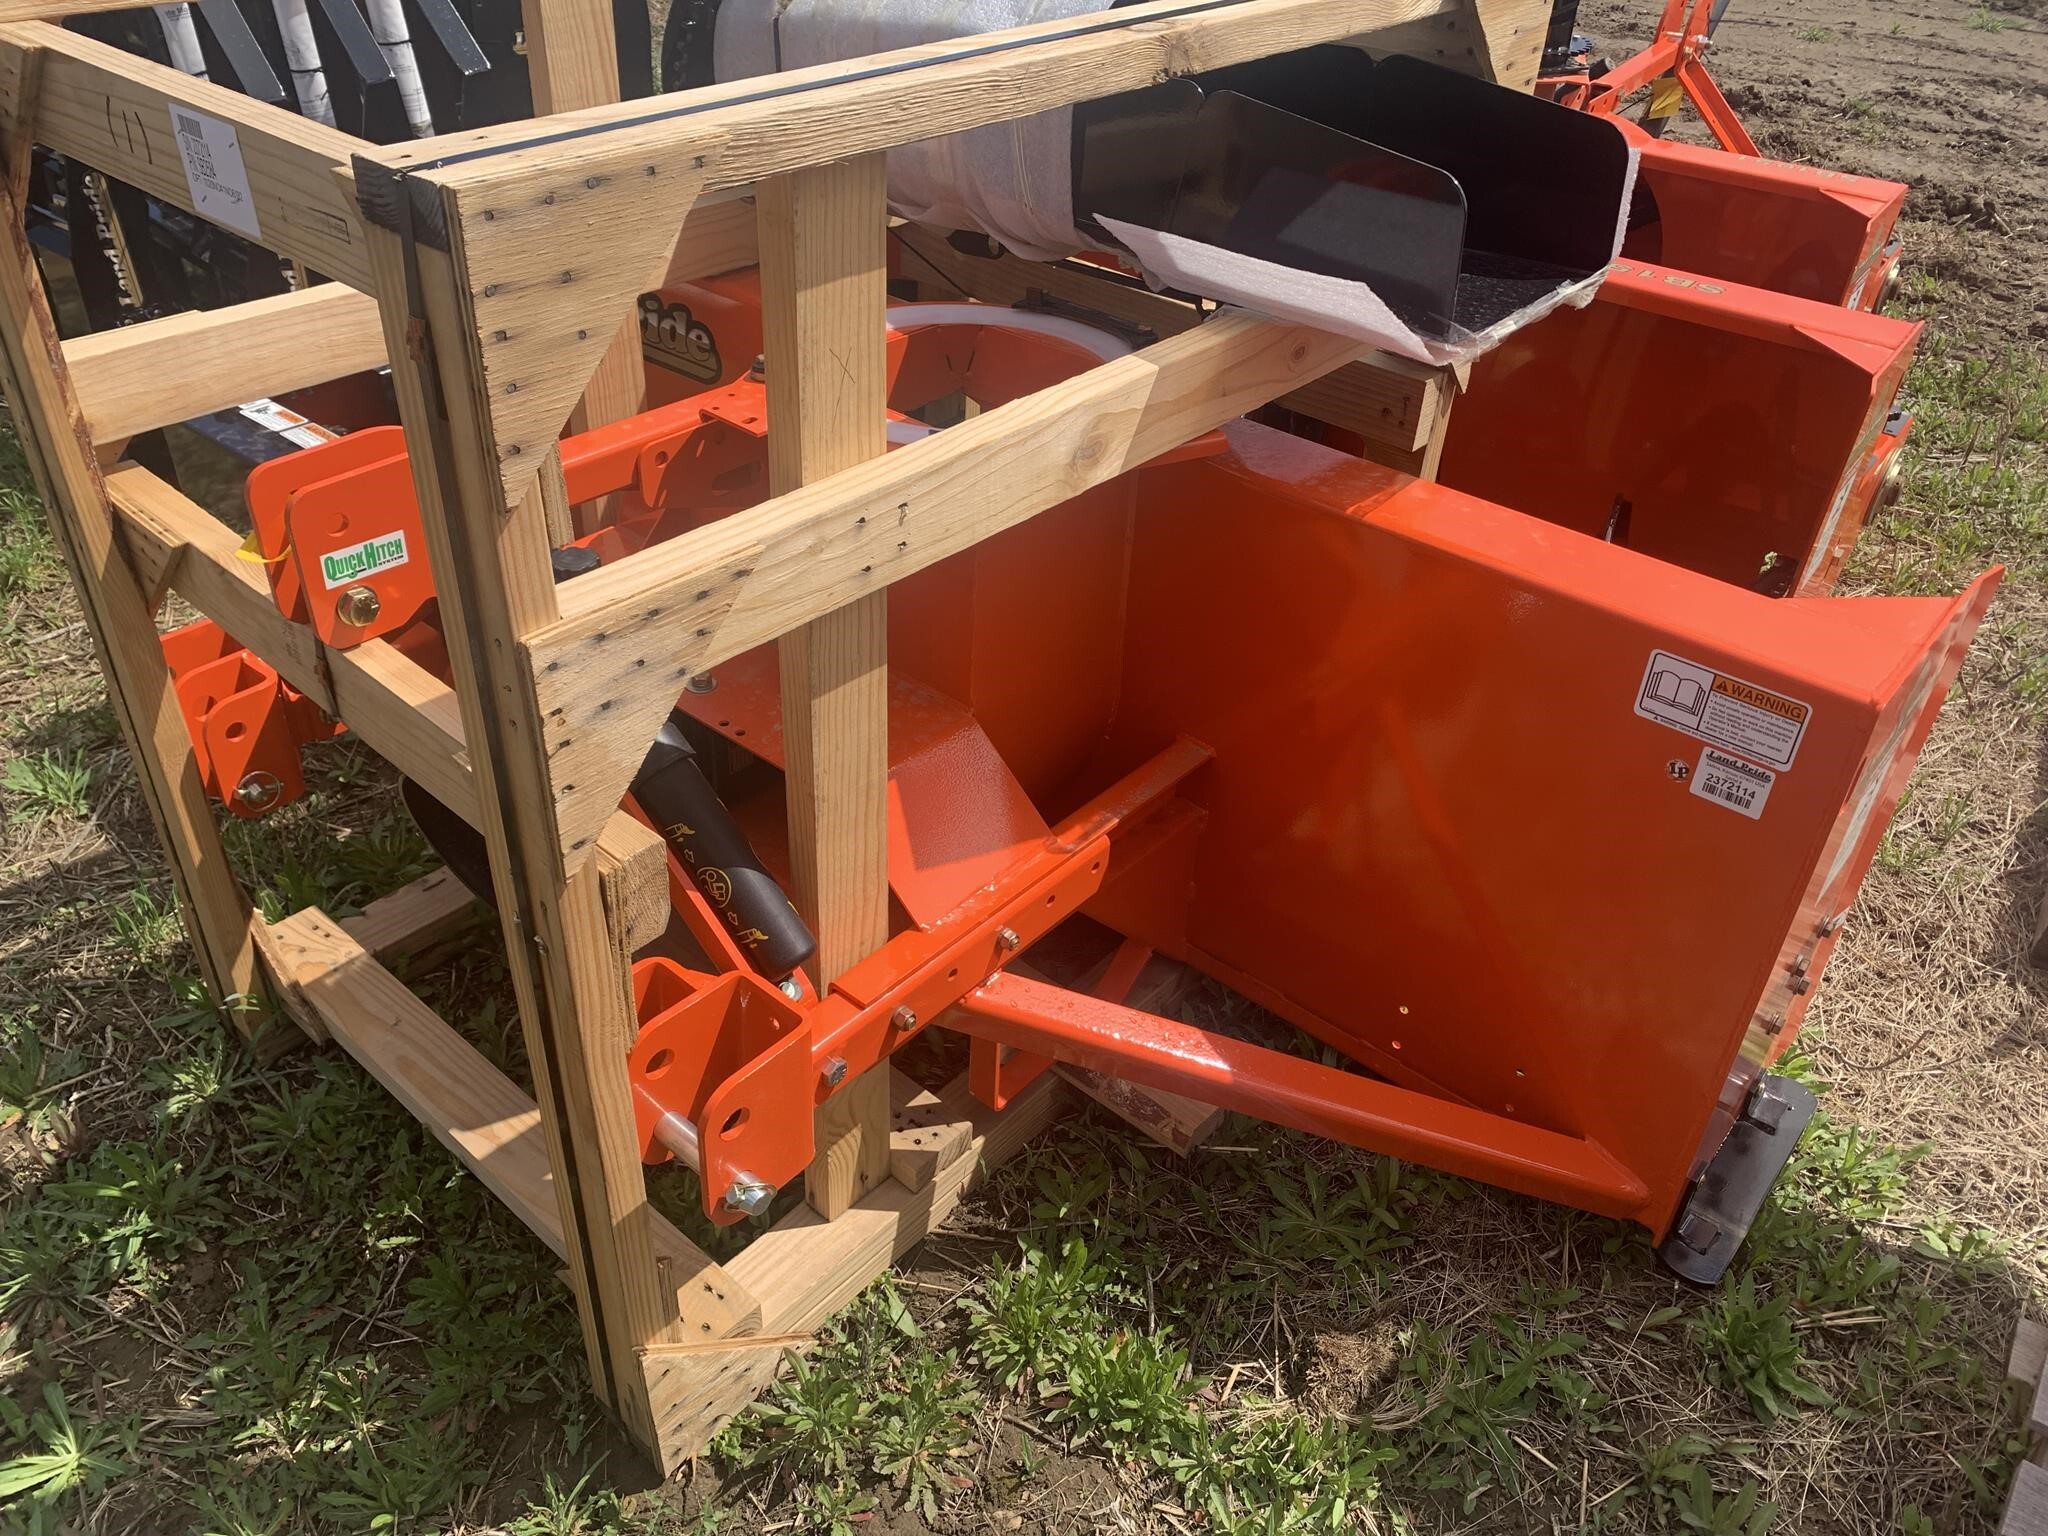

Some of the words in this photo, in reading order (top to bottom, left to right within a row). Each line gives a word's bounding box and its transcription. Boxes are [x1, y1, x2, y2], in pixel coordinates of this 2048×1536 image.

[1729, 683, 1803, 719] WARNING
[1705, 749, 1740, 769] Land
[1739, 762, 1773, 782] Pride
[1704, 772, 1757, 799] 2372114
